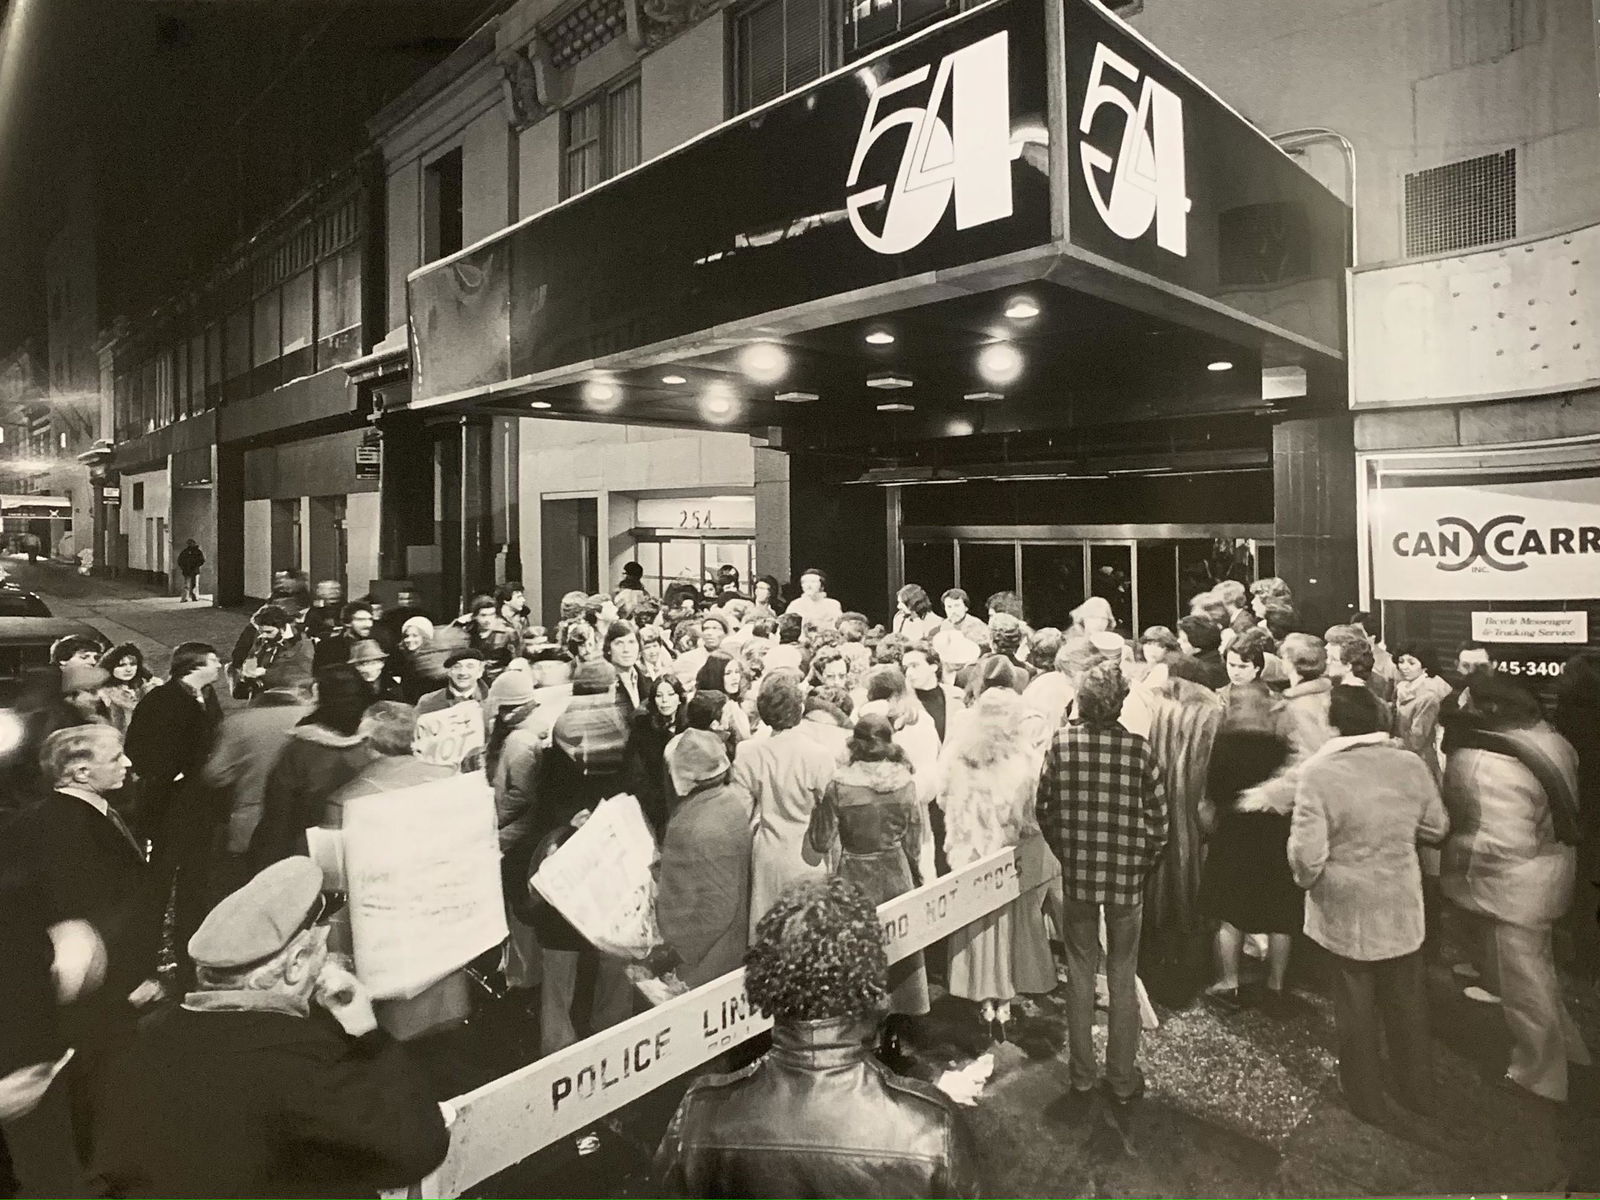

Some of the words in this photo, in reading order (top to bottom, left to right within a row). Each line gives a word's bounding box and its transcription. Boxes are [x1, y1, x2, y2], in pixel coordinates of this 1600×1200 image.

[846, 30, 1024, 254] 54
[1079, 42, 1192, 257] 54
[679, 509, 713, 529] 254
[1494, 629, 1536, 638] Trucking
[1538, 629, 1577, 637] Service
[1520, 617, 1573, 626] Messenger
[551, 1026, 672, 1112] POLICE
[703, 992, 759, 1039] LIN
